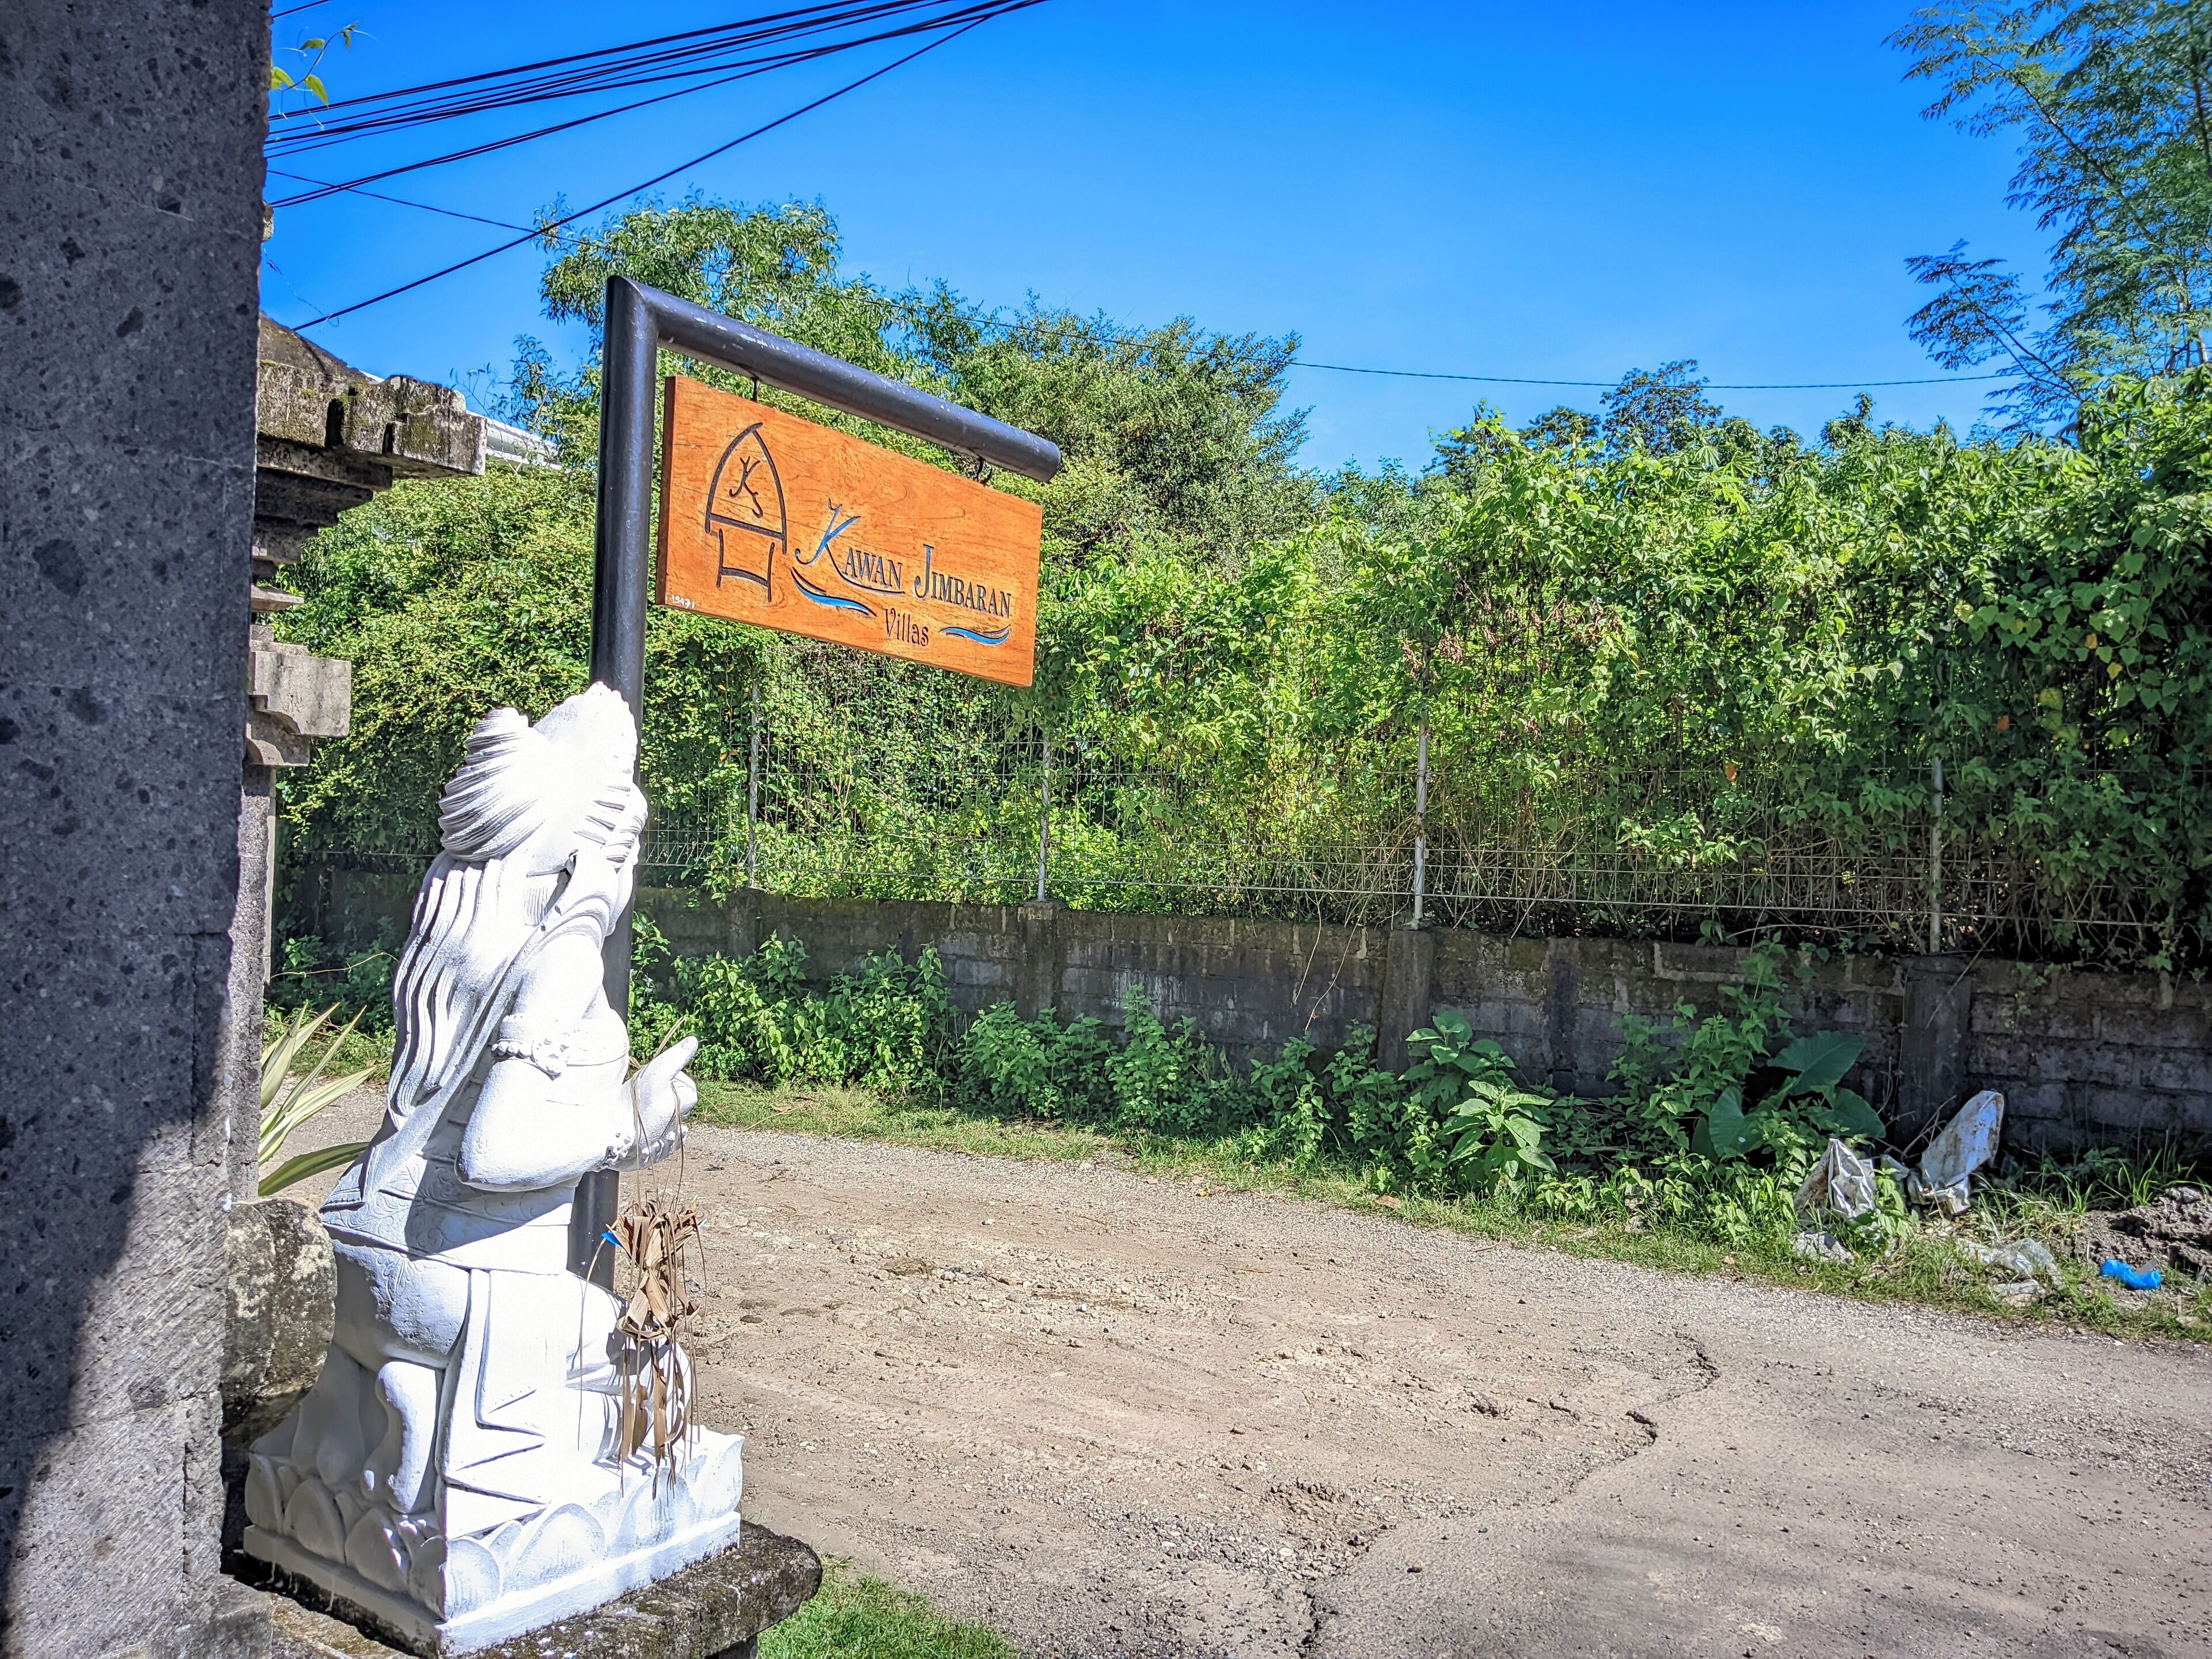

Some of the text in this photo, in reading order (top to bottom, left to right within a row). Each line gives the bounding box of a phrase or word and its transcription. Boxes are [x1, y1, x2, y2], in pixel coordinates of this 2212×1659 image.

[794, 498, 1012, 619] KAWAN JIMBARAN
[885, 608, 929, 647] Villas
